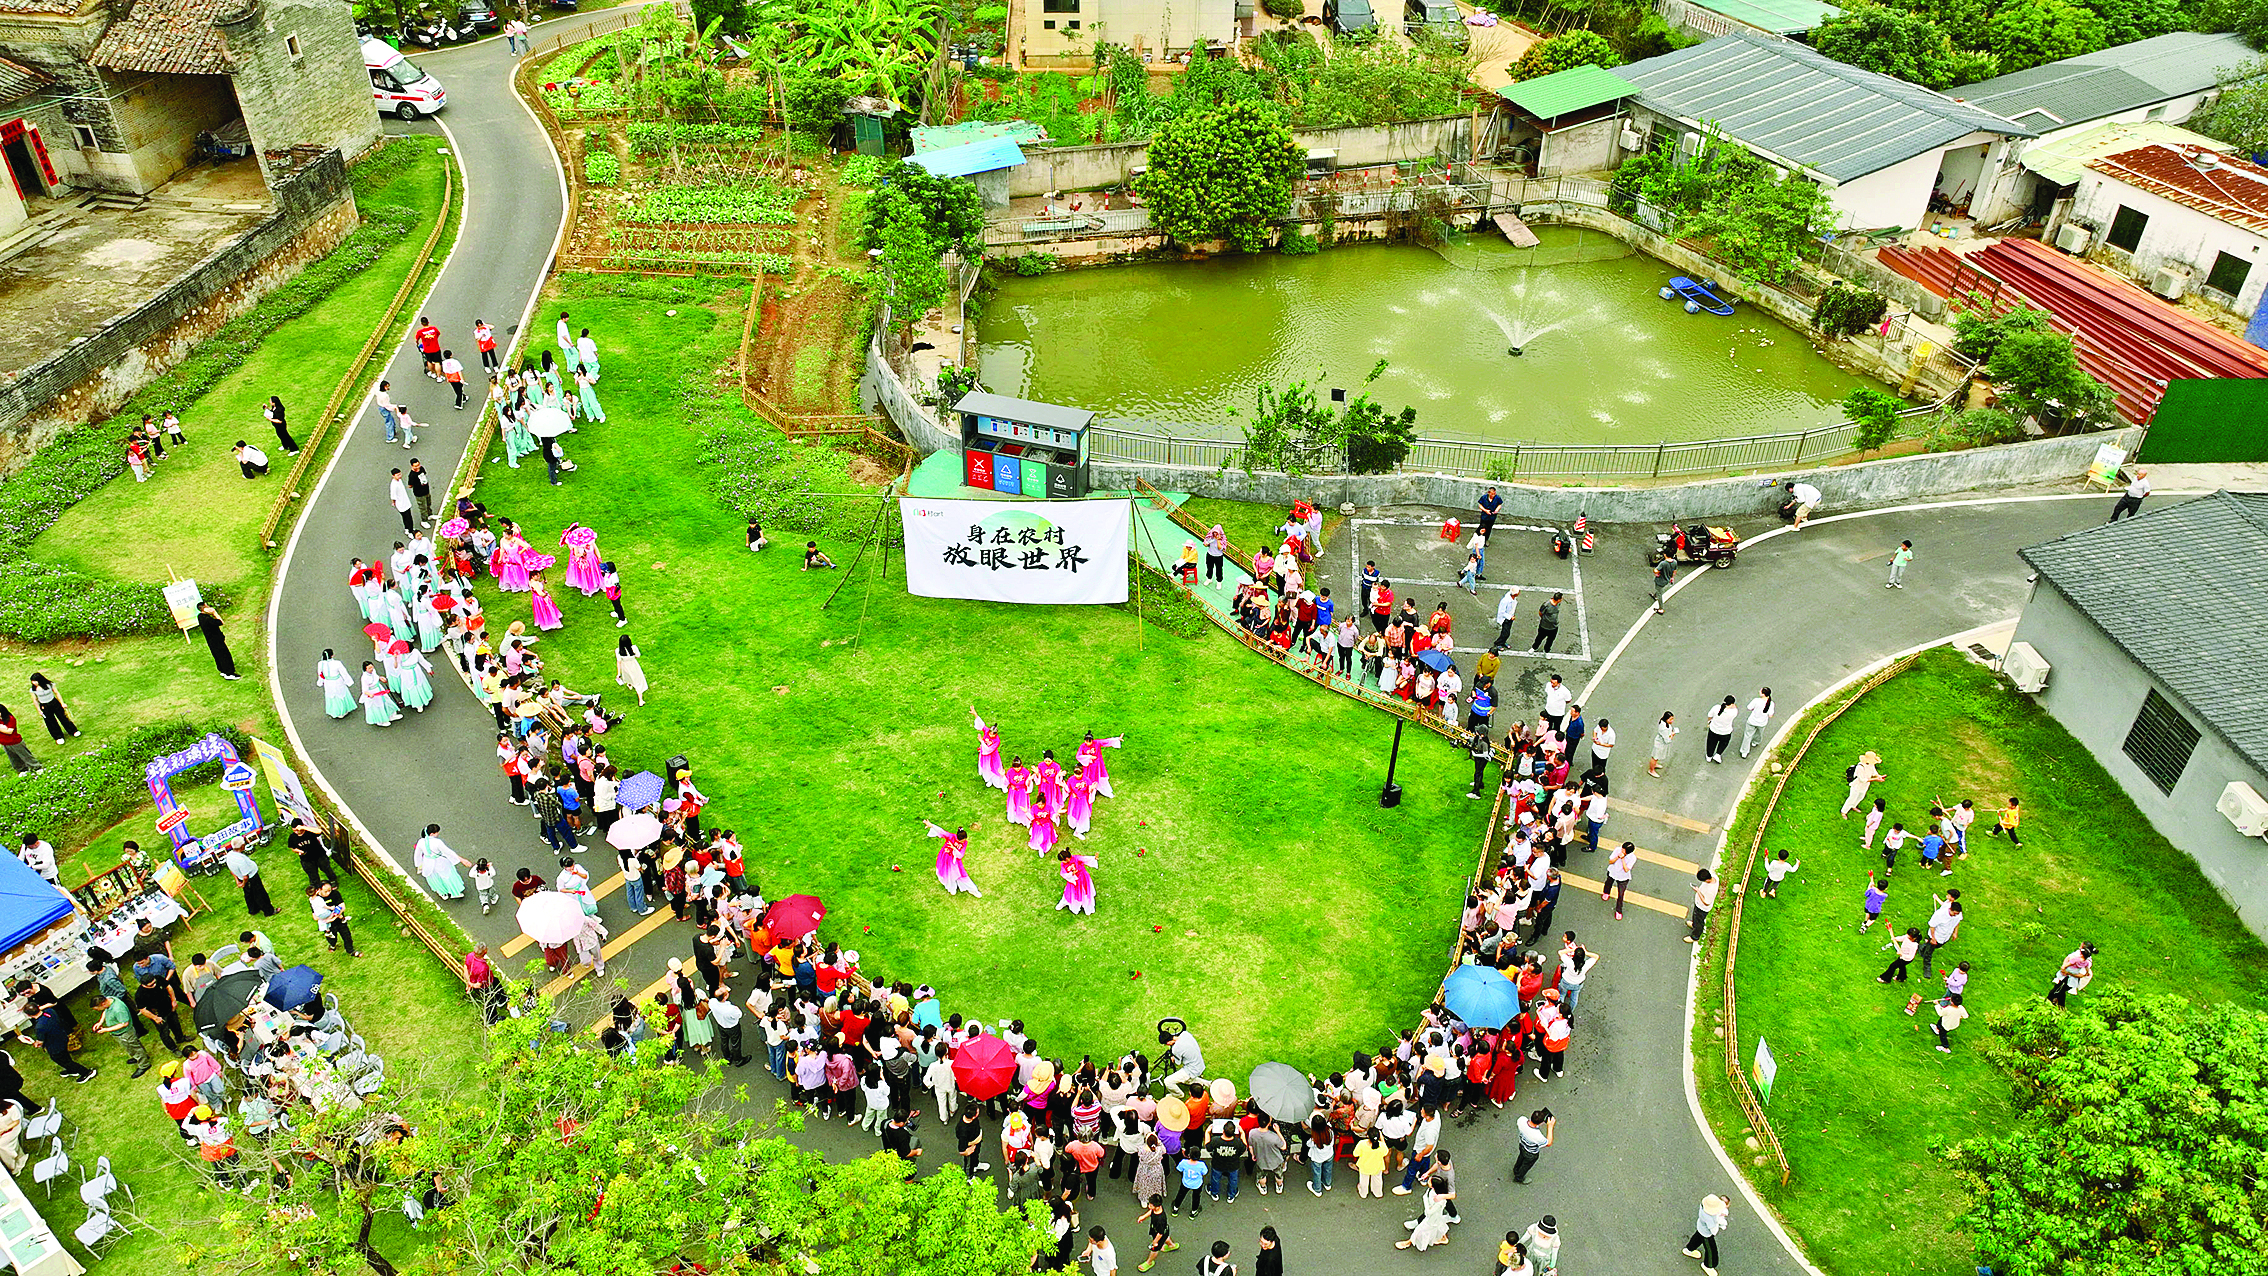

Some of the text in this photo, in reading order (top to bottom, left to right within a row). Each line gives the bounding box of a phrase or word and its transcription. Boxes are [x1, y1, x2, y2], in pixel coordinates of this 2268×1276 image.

[967, 523, 1066, 545] 身在农村
[943, 543, 1088, 573] 放眼世界
